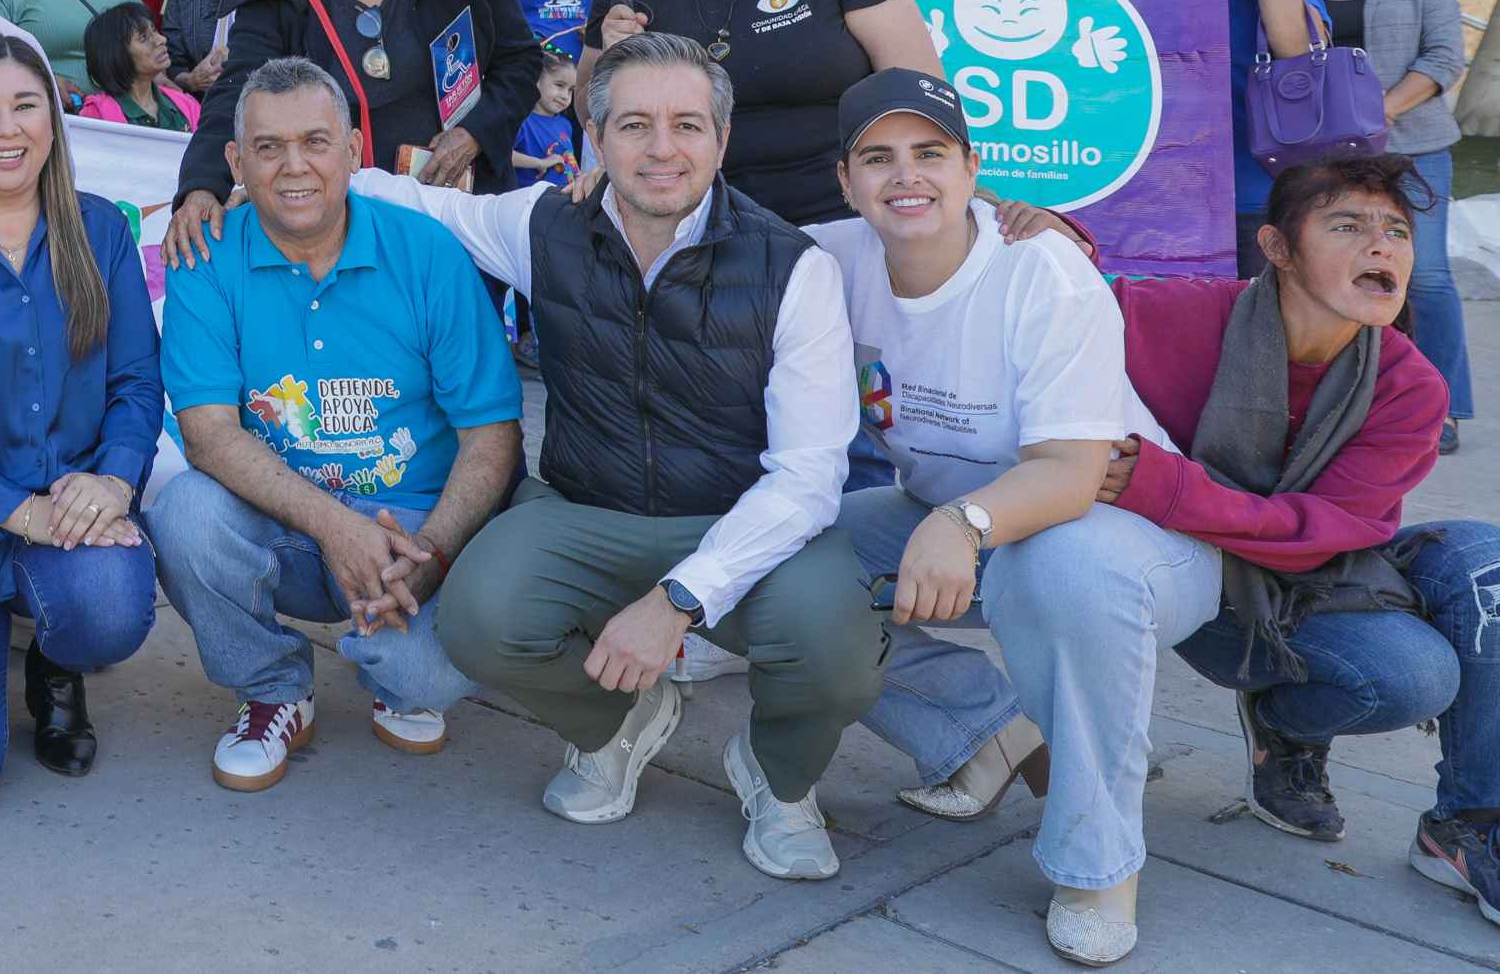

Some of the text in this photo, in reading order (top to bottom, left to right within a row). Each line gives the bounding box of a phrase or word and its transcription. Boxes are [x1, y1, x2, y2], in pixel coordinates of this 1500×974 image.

[751, 12, 794, 29] COMUNIDAD
[772, 20, 791, 30] BAJA
[953, 65, 1070, 131] SD
[970, 138, 1103, 166] rmosillo
[977, 167, 1070, 181] ación de familias
[318, 379, 400, 398] DEFIENDE,
[901, 383, 917, 392] Red
[948, 391, 957, 400] de
[321, 399, 379, 419] APOYA,
[900, 405, 935, 417] Binational
[961, 417, 971, 425] of
